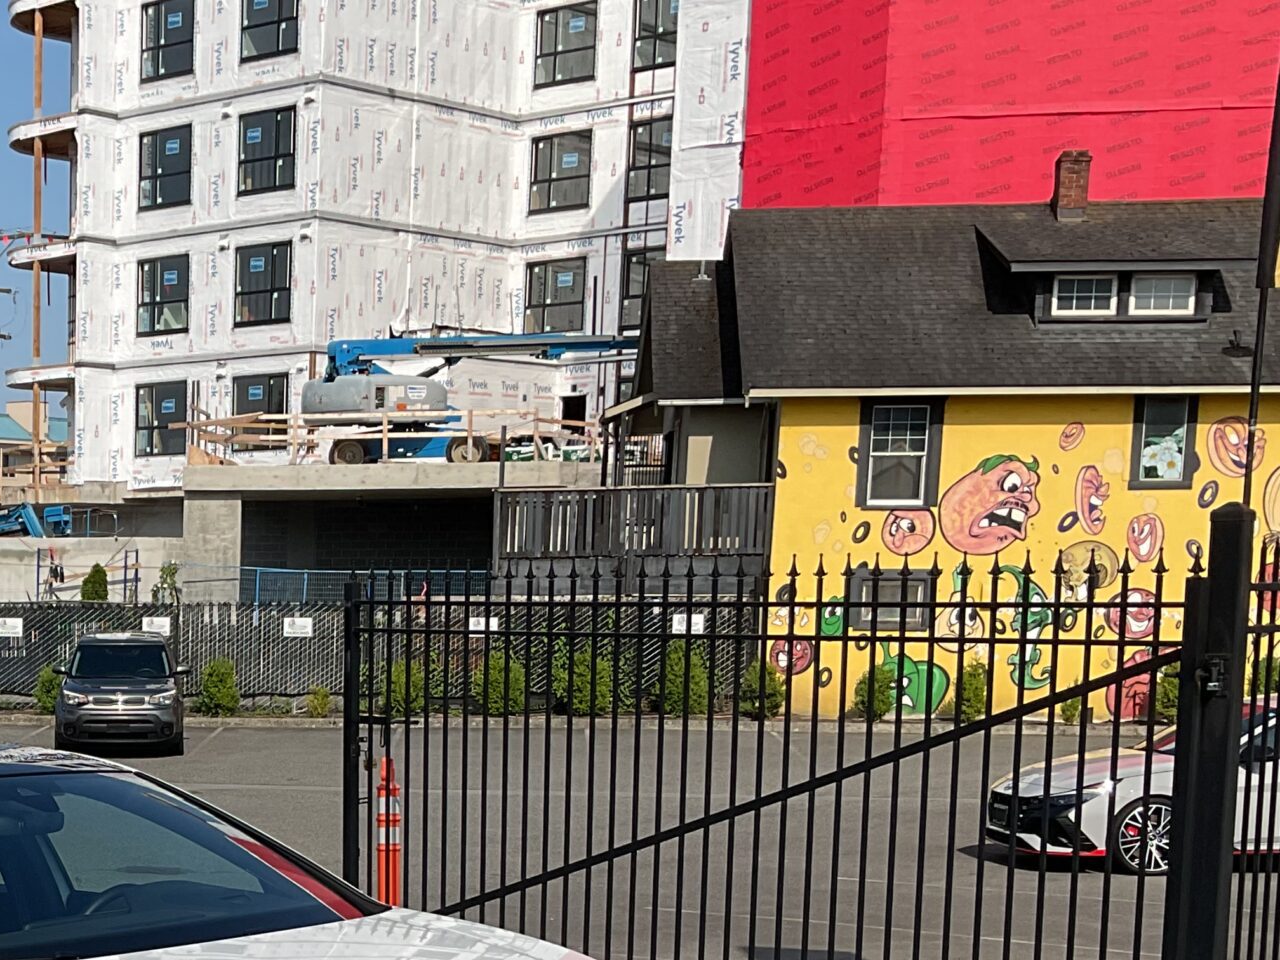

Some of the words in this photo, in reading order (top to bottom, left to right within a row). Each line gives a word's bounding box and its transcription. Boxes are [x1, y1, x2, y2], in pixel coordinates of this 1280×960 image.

[117, 10, 125, 37] yvek
[215, 40, 224, 76] Tyvek
[336, 38, 345, 73] Tyvek
[368, 38, 376, 72] Tyvek
[388, 42, 396, 76] Tyvek
[430, 51, 438, 85] Tyvek
[728, 38, 742, 82] Tyvek
[85, 55, 93, 88] Tyvek
[117, 61, 126, 94] Tyvek
[539, 115, 567, 129] Tyvek
[585, 108, 614, 122] Tyvek
[635, 100, 664, 115] Tyvek
[311, 120, 320, 155] Tyvek
[724, 111, 738, 145] Tyve
[82, 133, 91, 159] yvek
[376, 130, 384, 165] Tyvek
[351, 157, 359, 191] Tyvek
[83, 184, 91, 217] Tyvek
[213, 174, 221, 208] Tyvek
[309, 181, 318, 209] Tyve
[614, 233, 643, 245] Tvek
[673, 202, 686, 245] Tyvek
[520, 244, 547, 256] Tyvek
[567, 238, 595, 252] Tyvek
[81, 260, 90, 287] yvek
[114, 264, 122, 290] yvek
[211, 252, 219, 279] yvek
[328, 247, 338, 282] Tyvek
[458, 258, 466, 290] Tyvek
[376, 270, 384, 303] Tyvek
[422, 277, 430, 310] Tyvek
[513, 288, 522, 319] Tyvek
[81, 311, 89, 343] Tyvek
[113, 314, 121, 346] Tyvek
[209, 304, 218, 337] Tyvek
[468, 378, 488, 391] Tyvek
[565, 364, 592, 376] Tyvek
[533, 382, 553, 395] Tyvek
[111, 395, 120, 426] Tyvek
[111, 450, 120, 480] Tyvek
[133, 476, 157, 486] Tyvek
